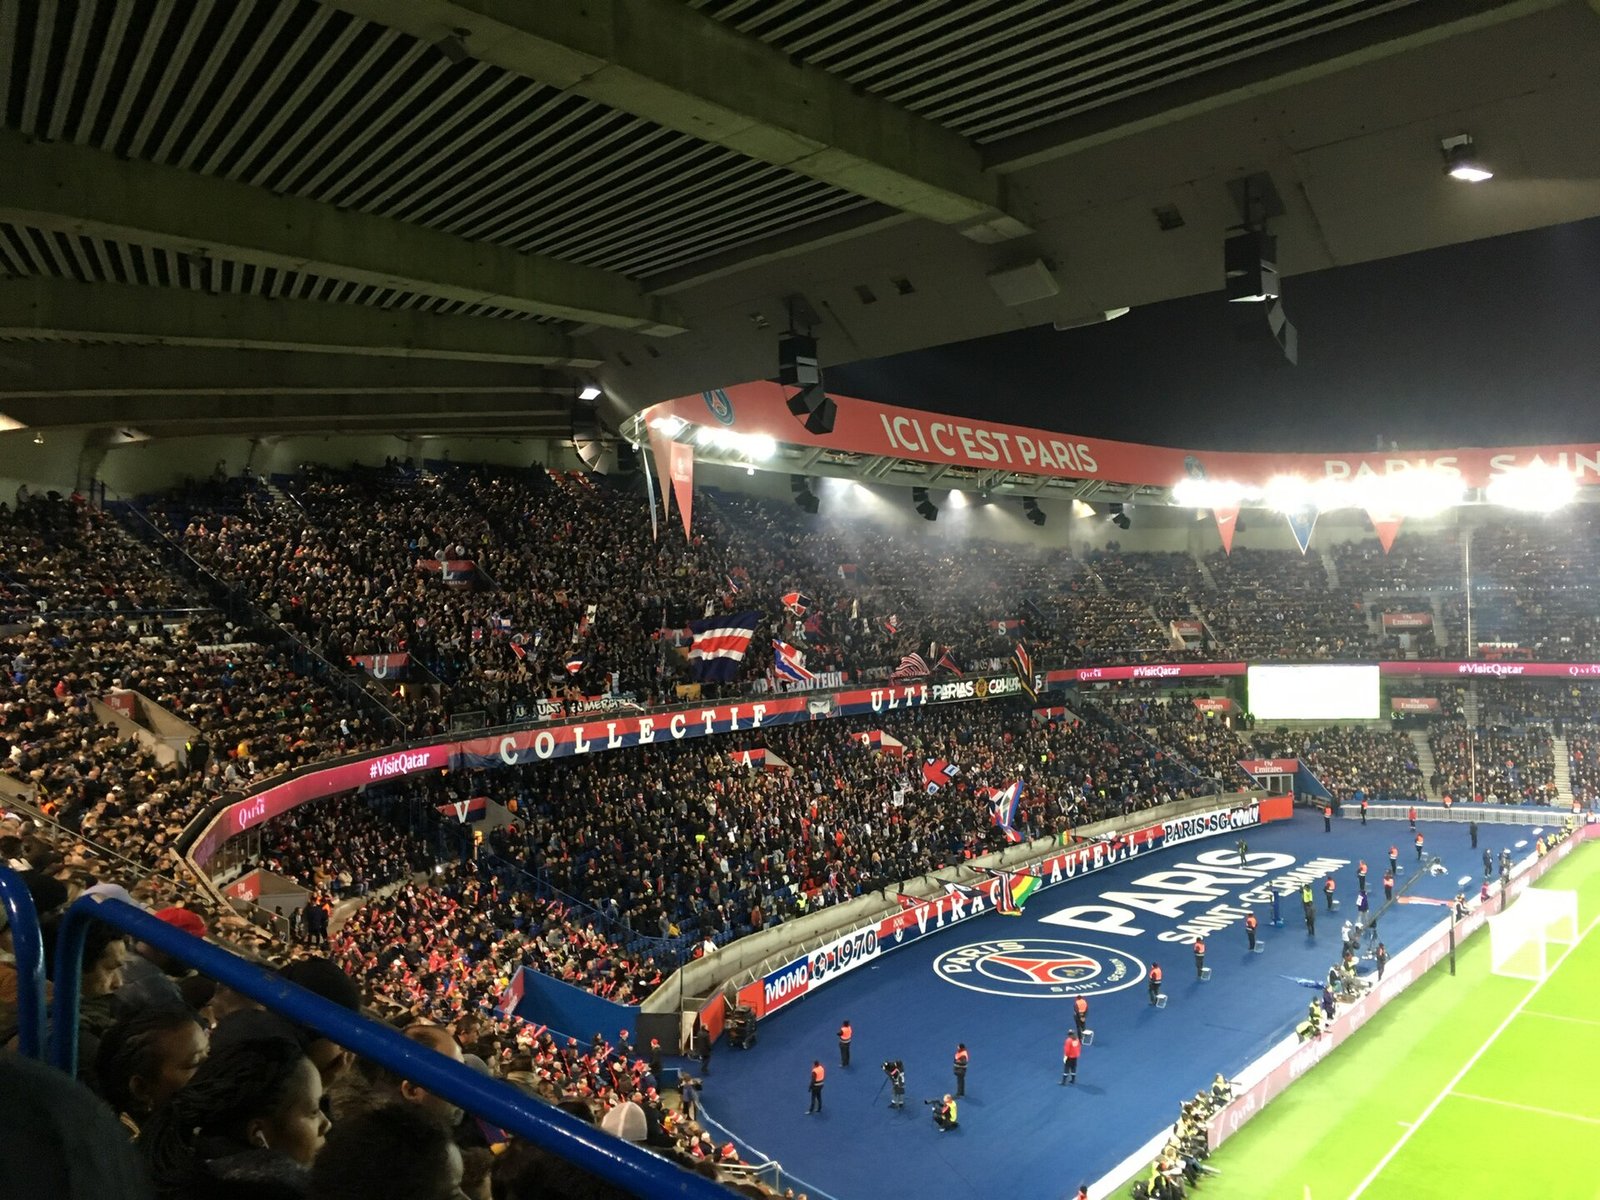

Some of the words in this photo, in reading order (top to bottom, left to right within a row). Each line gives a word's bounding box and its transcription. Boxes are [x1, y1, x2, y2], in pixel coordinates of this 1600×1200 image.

[880, 414, 929, 453] ICI
[930, 422, 1013, 463] C'EST
[1015, 435, 1098, 473] PARIS
[1133, 667, 1181, 677] #VisitQatar
[1459, 663, 1525, 676] #VisitQatar
[500, 704, 767, 765] COLLECTIF
[369, 753, 430, 778] #VisitQatar
[742, 751, 753, 768] A
[454, 800, 470, 824] V
[1165, 817, 1205, 843] PARIS
[1050, 834, 1139, 884] AUTEUIL
[1038, 850, 1296, 937] PARIS
[764, 964, 808, 1005] MOMO
[832, 929, 876, 973] 1970
[942, 941, 1025, 974] PARIS
[1050, 982, 1101, 993] SAINT
